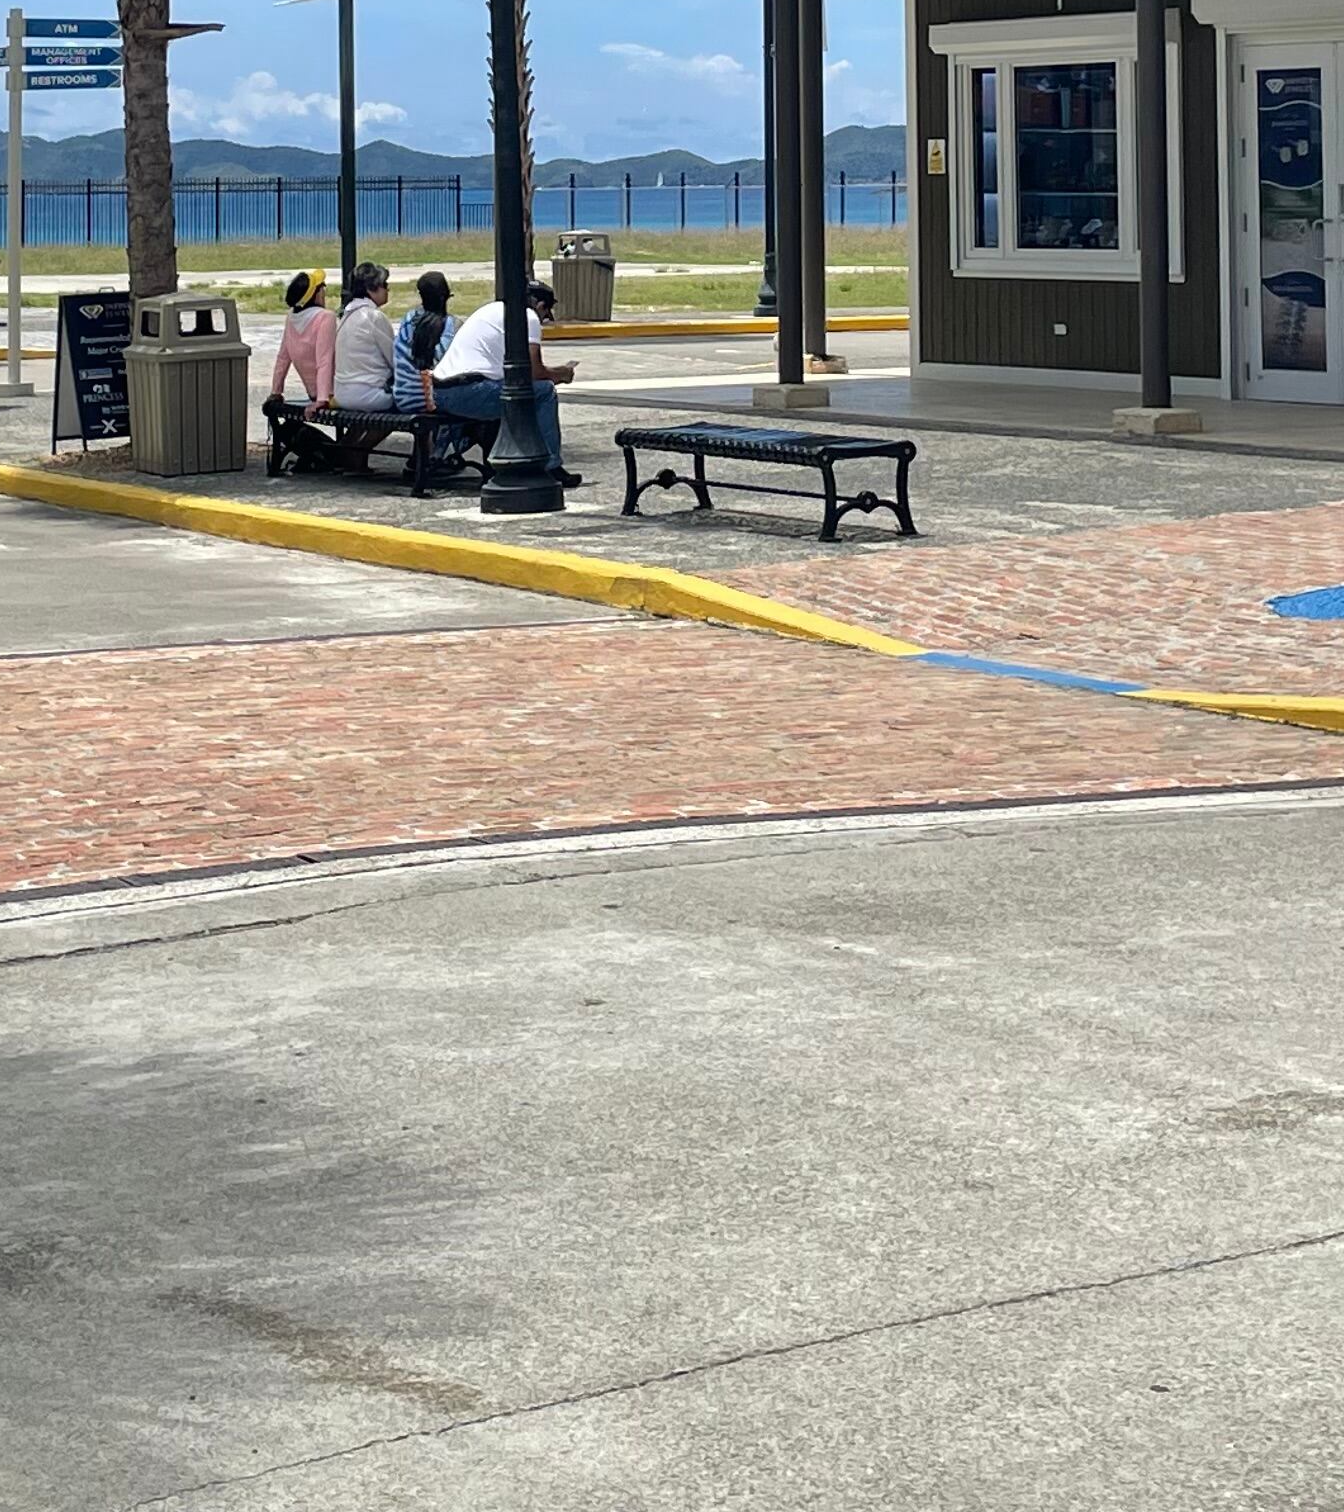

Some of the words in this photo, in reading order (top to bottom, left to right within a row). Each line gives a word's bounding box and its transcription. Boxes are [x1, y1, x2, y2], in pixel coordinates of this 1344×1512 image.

[54, 24, 78, 34] ATM
[31, 47, 102, 56] MANAGEMENT
[46, 55, 88, 65] OFFICES
[31, 74, 98, 85] RESTROOMS
